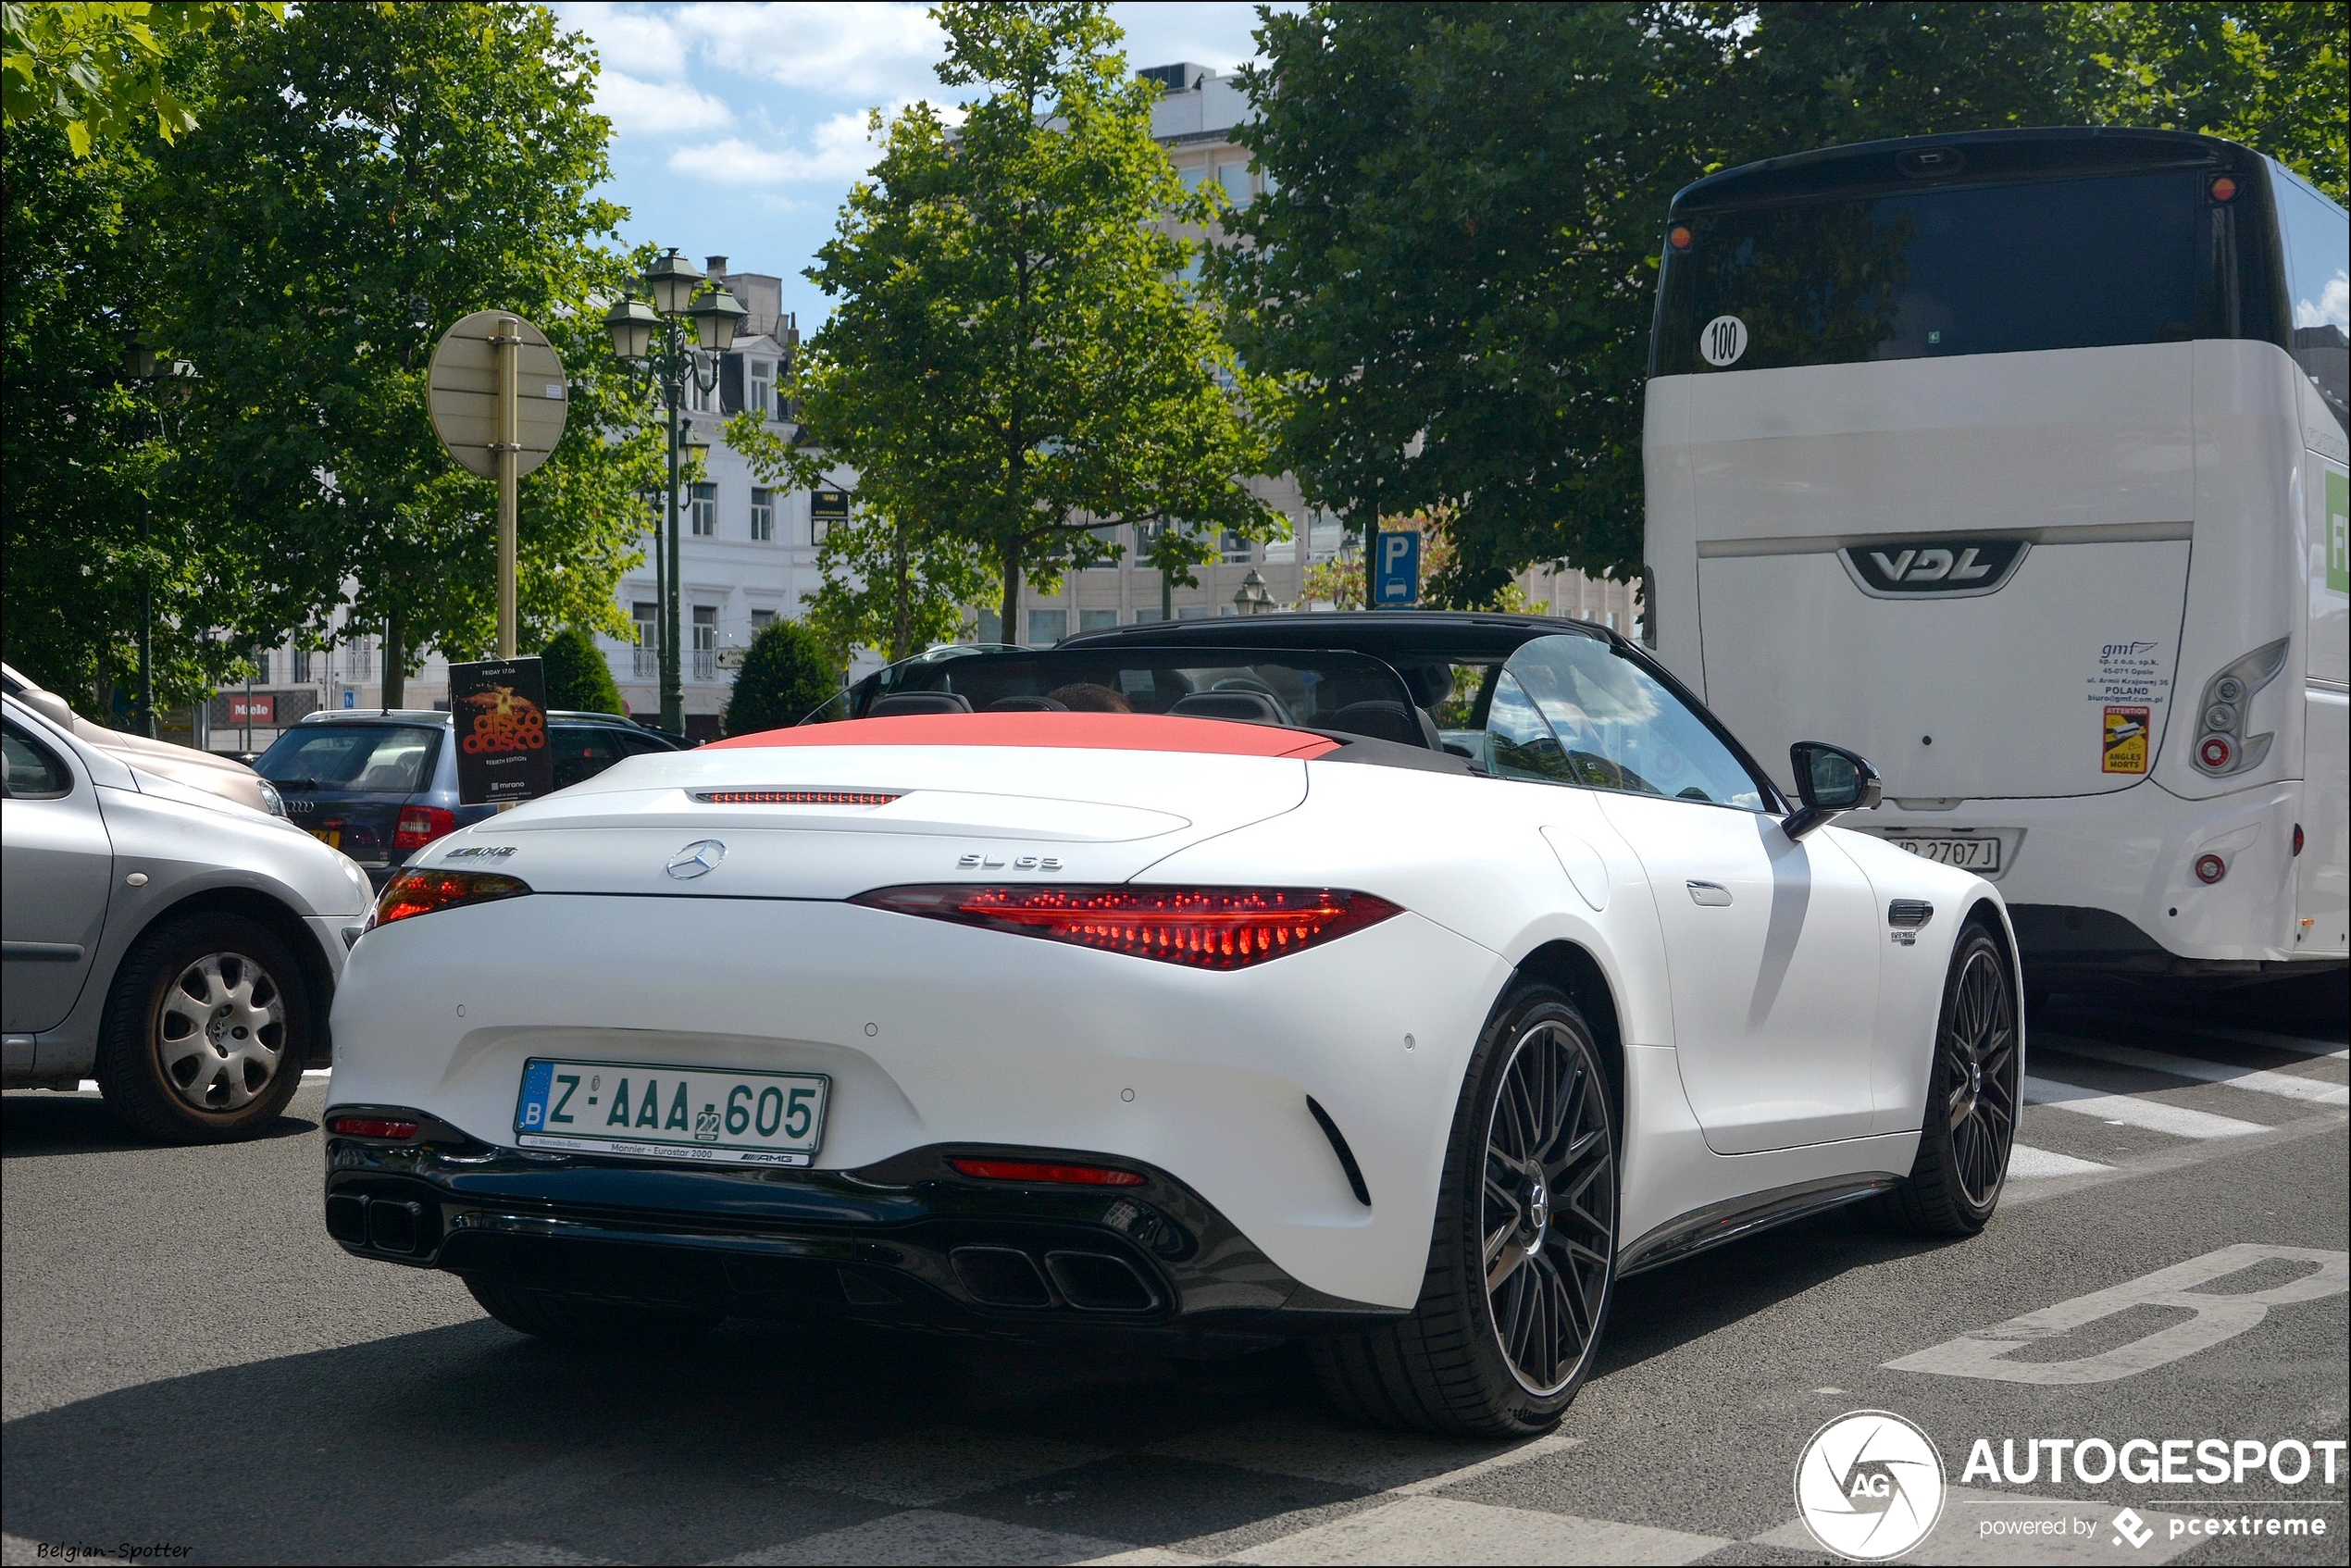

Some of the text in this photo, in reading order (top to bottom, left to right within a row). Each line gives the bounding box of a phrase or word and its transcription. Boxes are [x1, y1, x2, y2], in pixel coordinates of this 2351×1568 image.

[1711, 321, 1737, 360] 100
[1386, 537, 1409, 574] P
[1870, 548, 1992, 581] VDL
[2101, 641, 2142, 658] gmf
[2087, 694, 2163, 703] biuro@gmf.com.pl
[2105, 687, 2148, 695] POLAND
[474, 709, 543, 734] disco
[463, 730, 545, 754] dasco
[506, 755, 527, 764] EDITION
[959, 853, 1064, 869] SL 63
[526, 1102, 542, 1125] B
[695, 1113, 720, 1135] 22
[539, 1138, 581, 1149] Mercedes-Benz
[611, 1144, 645, 1153] Monnier
[653, 1147, 689, 1156] Eurostar
[691, 1150, 713, 1158] 2000
